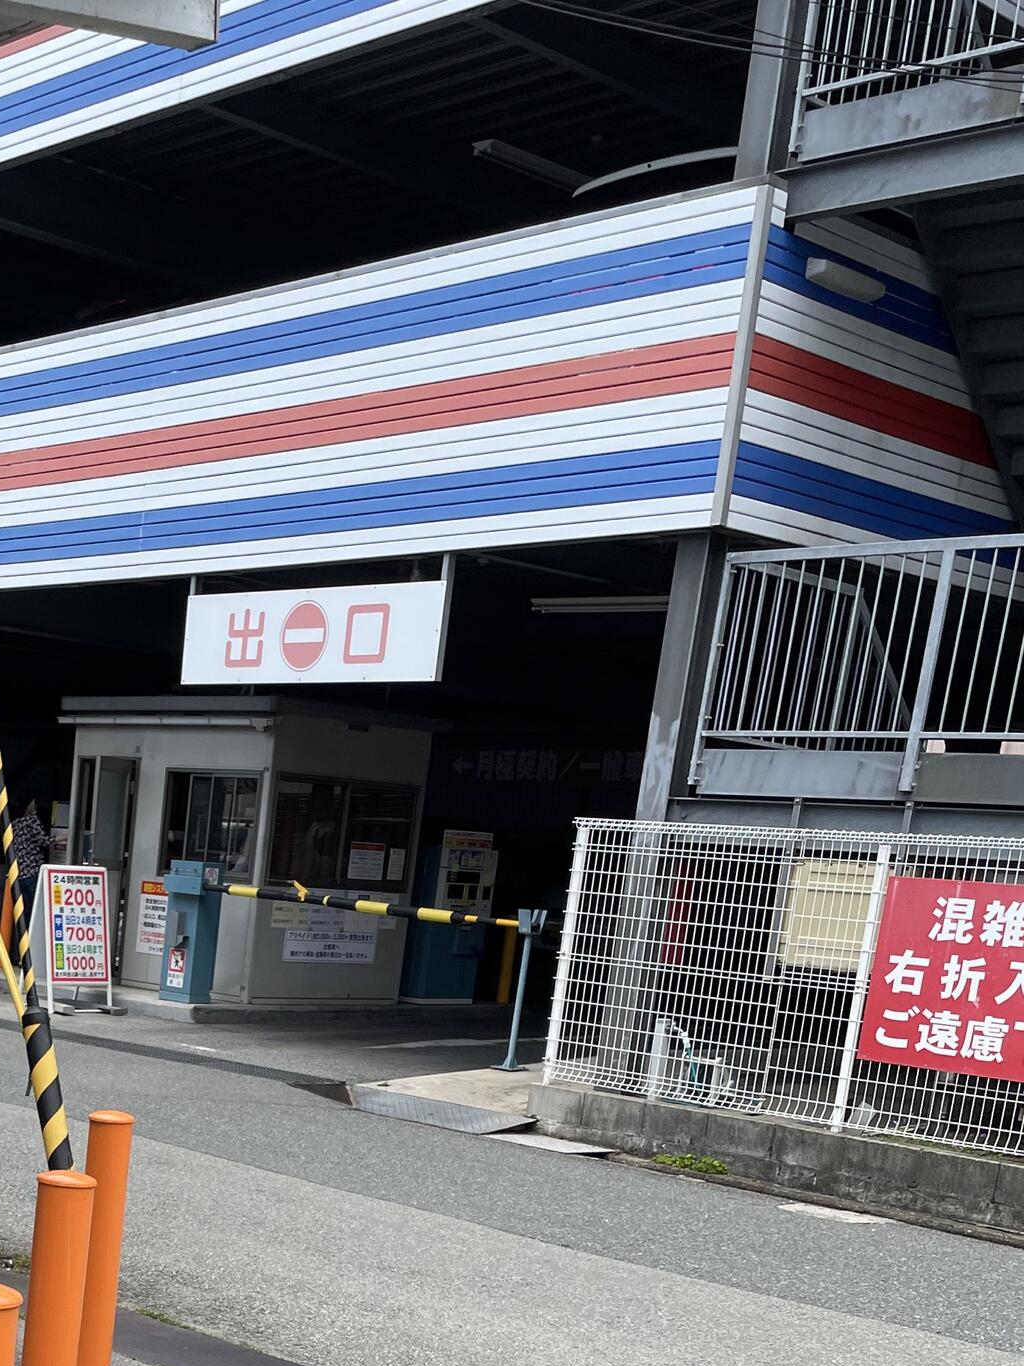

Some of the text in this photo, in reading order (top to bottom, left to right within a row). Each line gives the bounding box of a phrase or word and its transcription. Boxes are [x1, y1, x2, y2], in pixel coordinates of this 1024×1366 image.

[53, 875, 101, 886] 24時間営業
[65, 916, 102, 926] 当日24時まで
[928, 896, 1024, 948] 混雑
[66, 945, 104, 955] 当日24時まで
[875, 1005, 1024, 1064] ご遠慮
